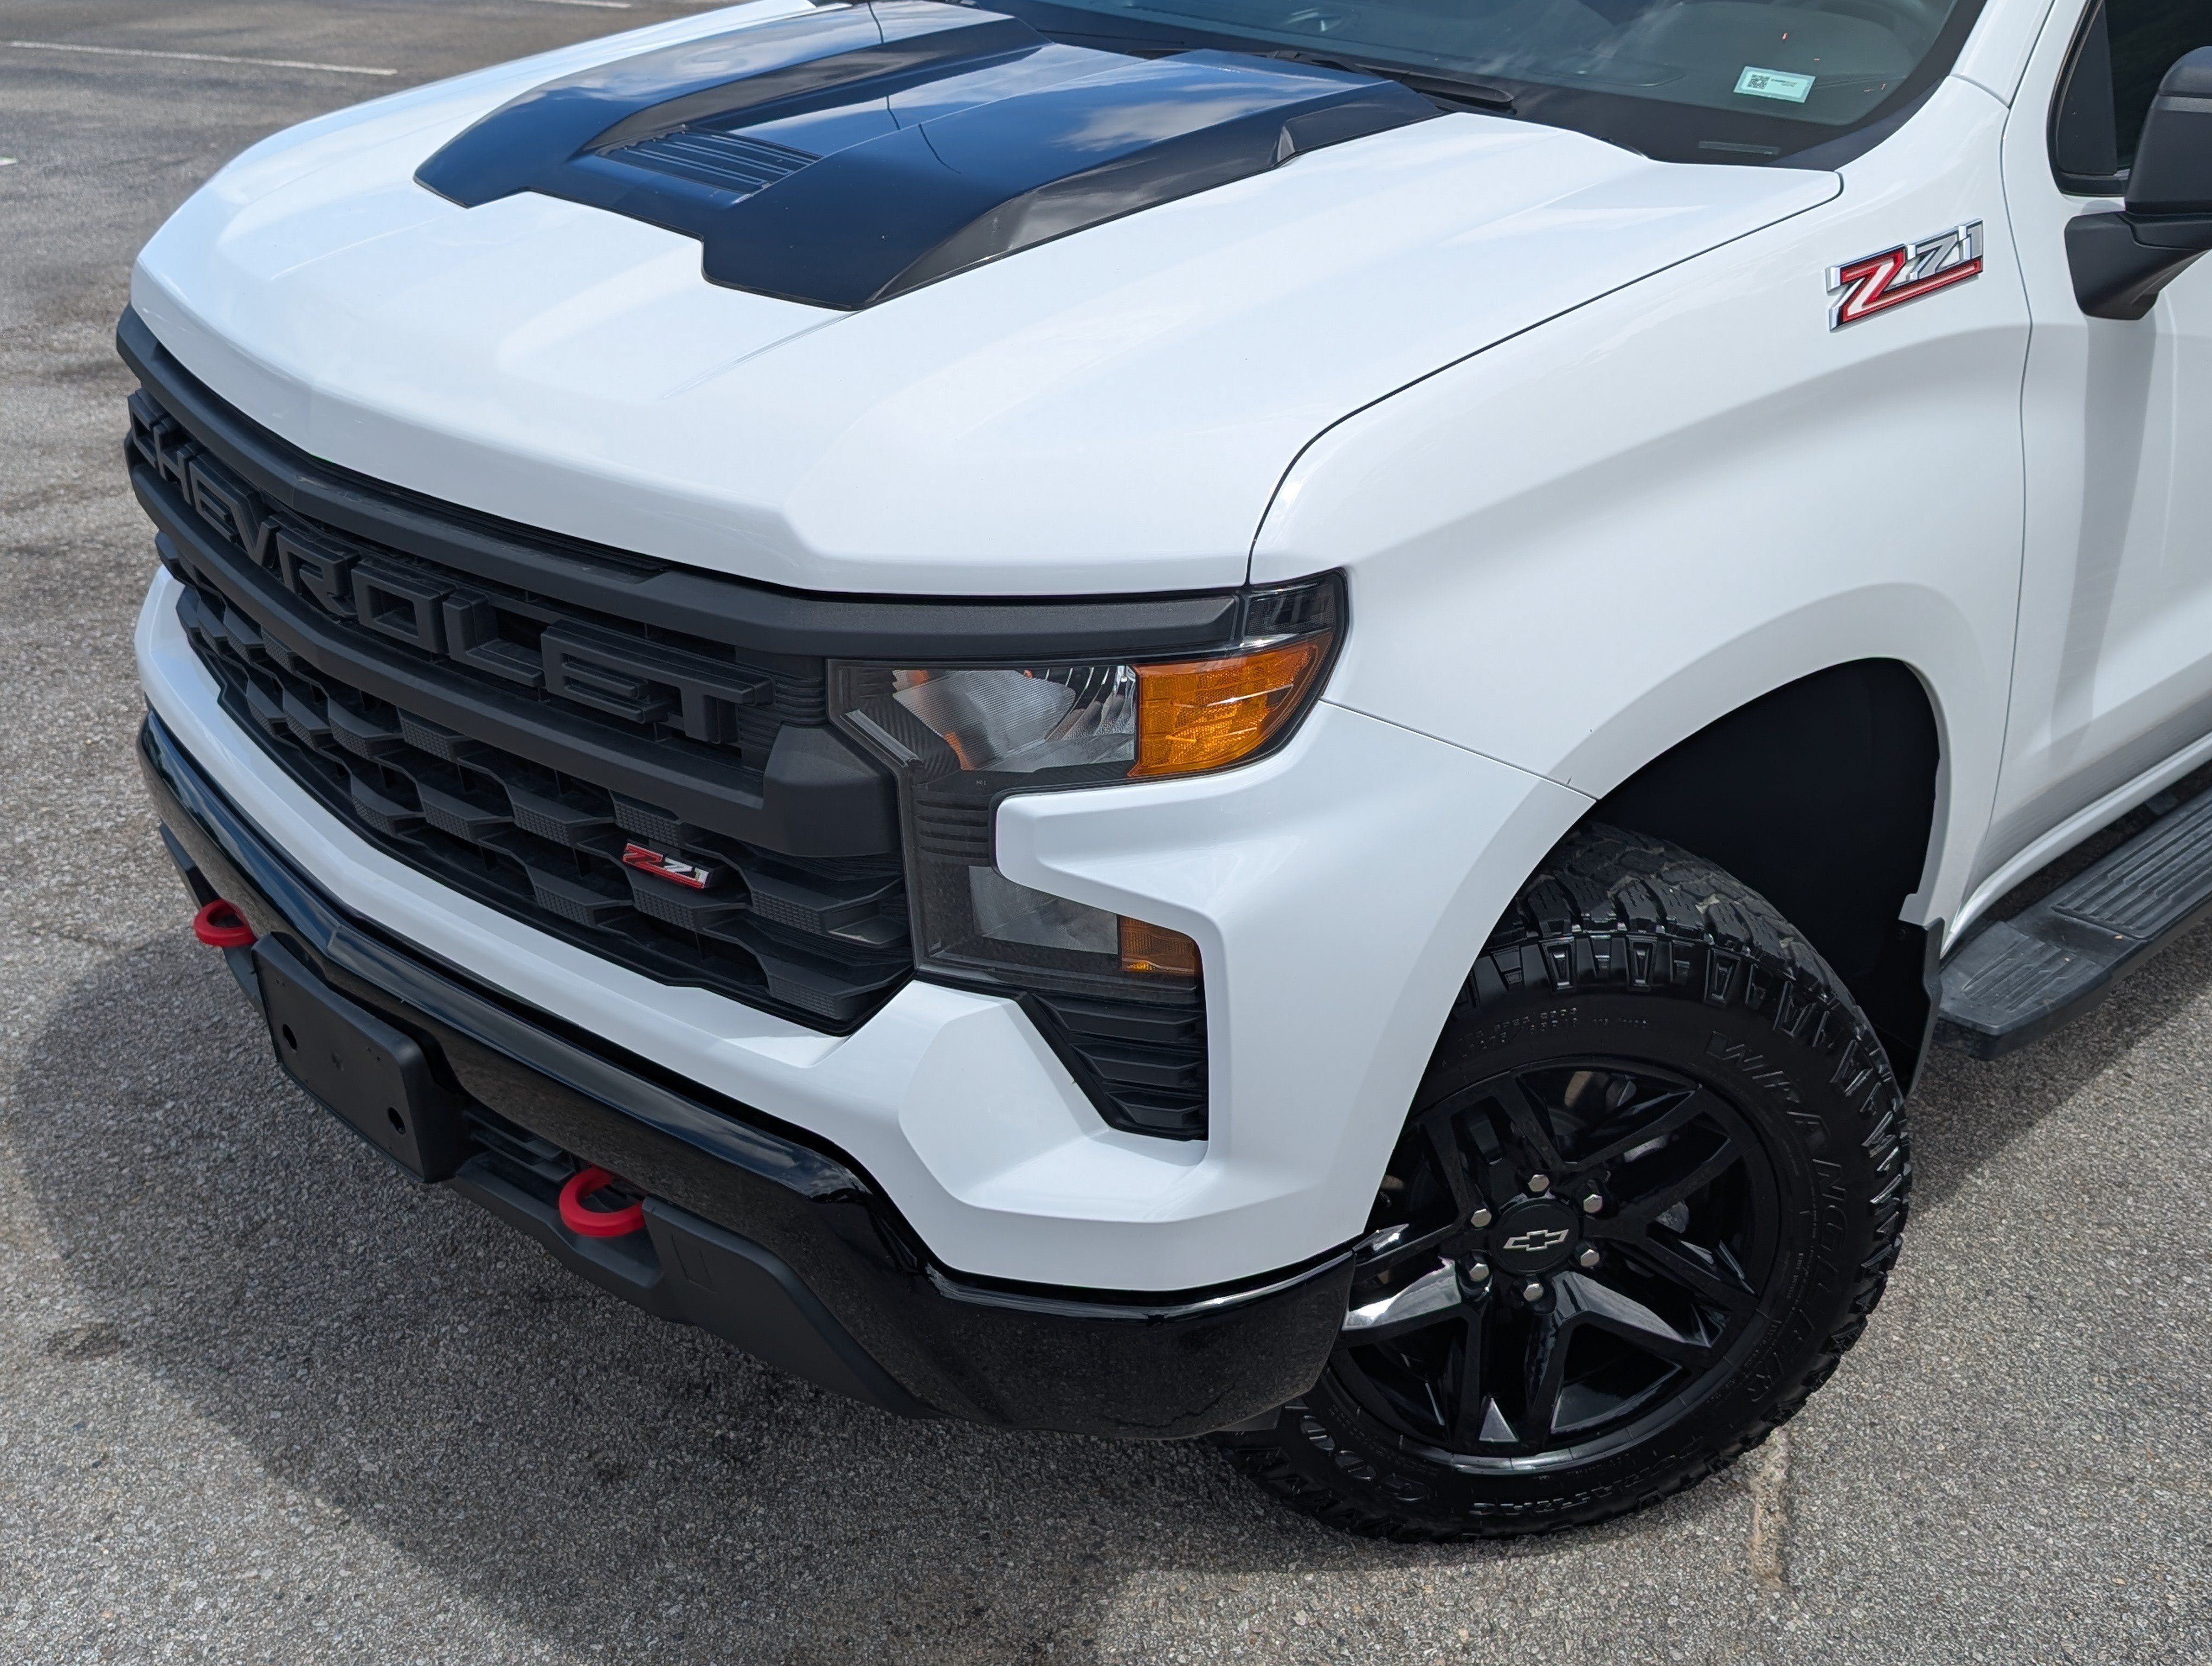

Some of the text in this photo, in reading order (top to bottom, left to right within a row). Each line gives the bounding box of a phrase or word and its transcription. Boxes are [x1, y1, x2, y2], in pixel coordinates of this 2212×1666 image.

[1825, 217, 1983, 330] Z71
[127, 388, 774, 744] CHEVROLET
[622, 842, 710, 889] Z71
